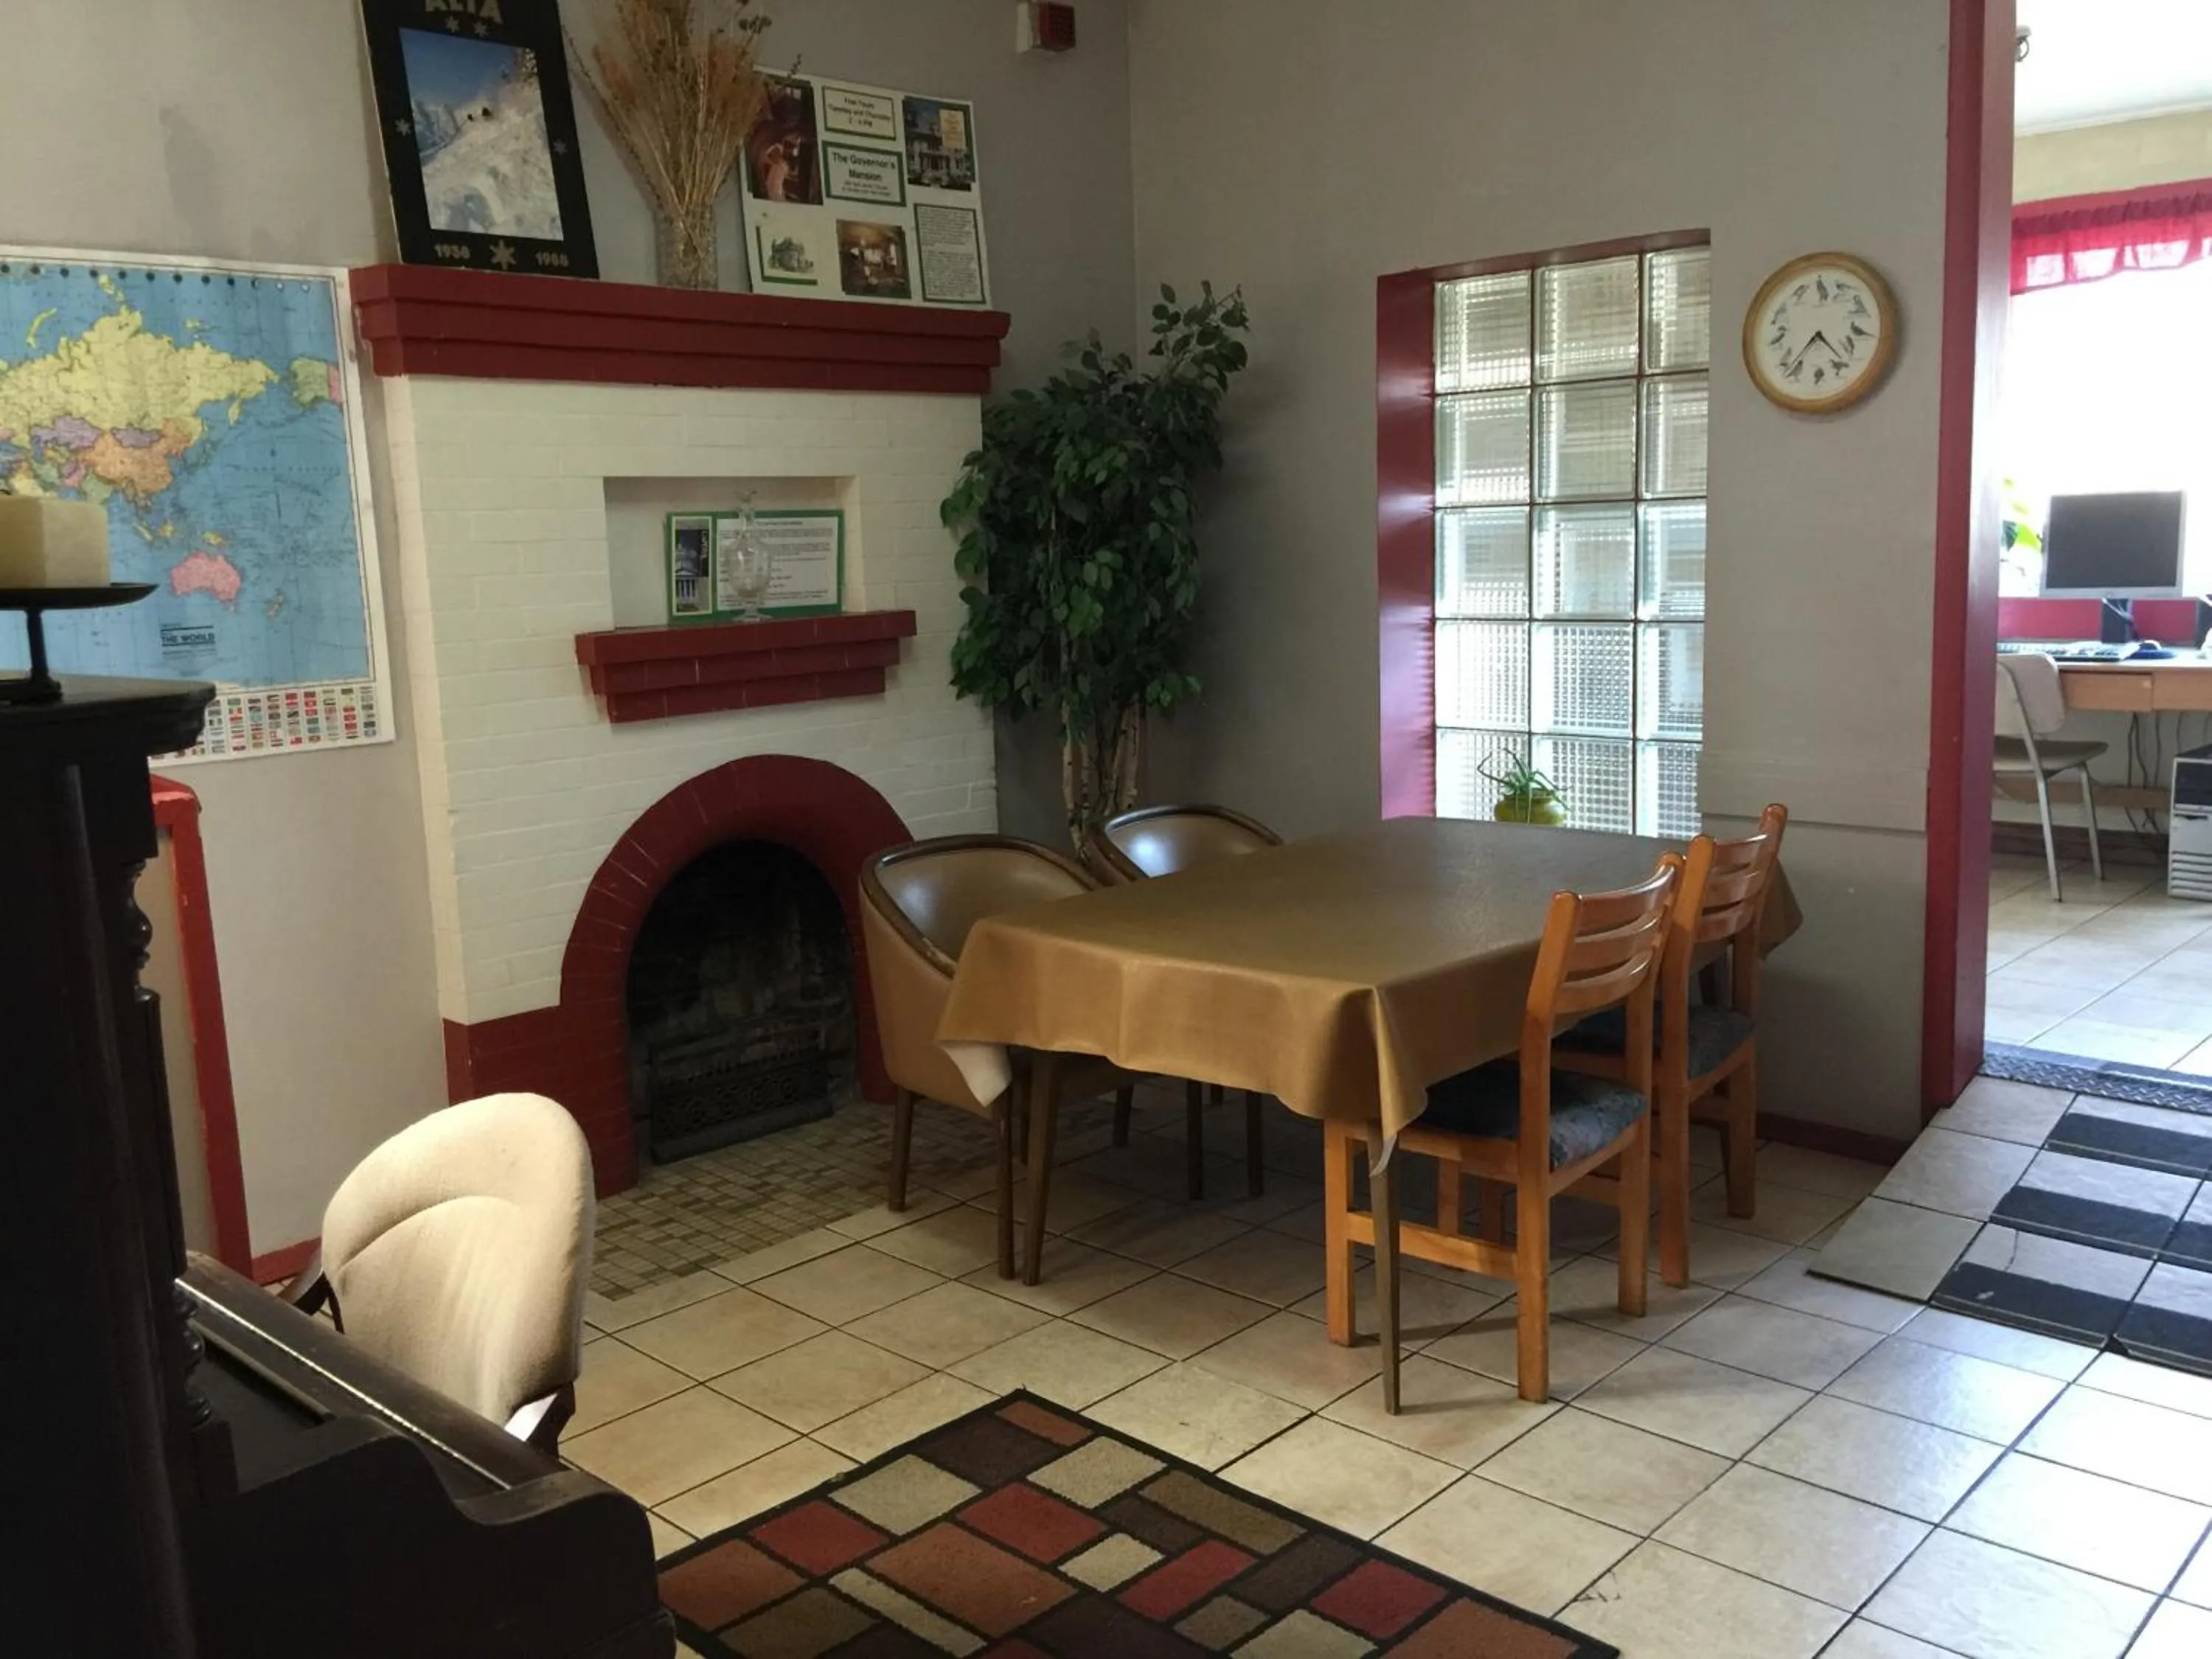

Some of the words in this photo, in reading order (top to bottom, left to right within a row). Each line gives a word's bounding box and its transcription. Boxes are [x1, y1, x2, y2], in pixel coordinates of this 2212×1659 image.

[832, 151, 848, 163] The
[849, 154, 897, 170] Governor's
[849, 169, 883, 182] Mansion
[161, 635, 178, 644] THE
[181, 632, 215, 641] WORLD
